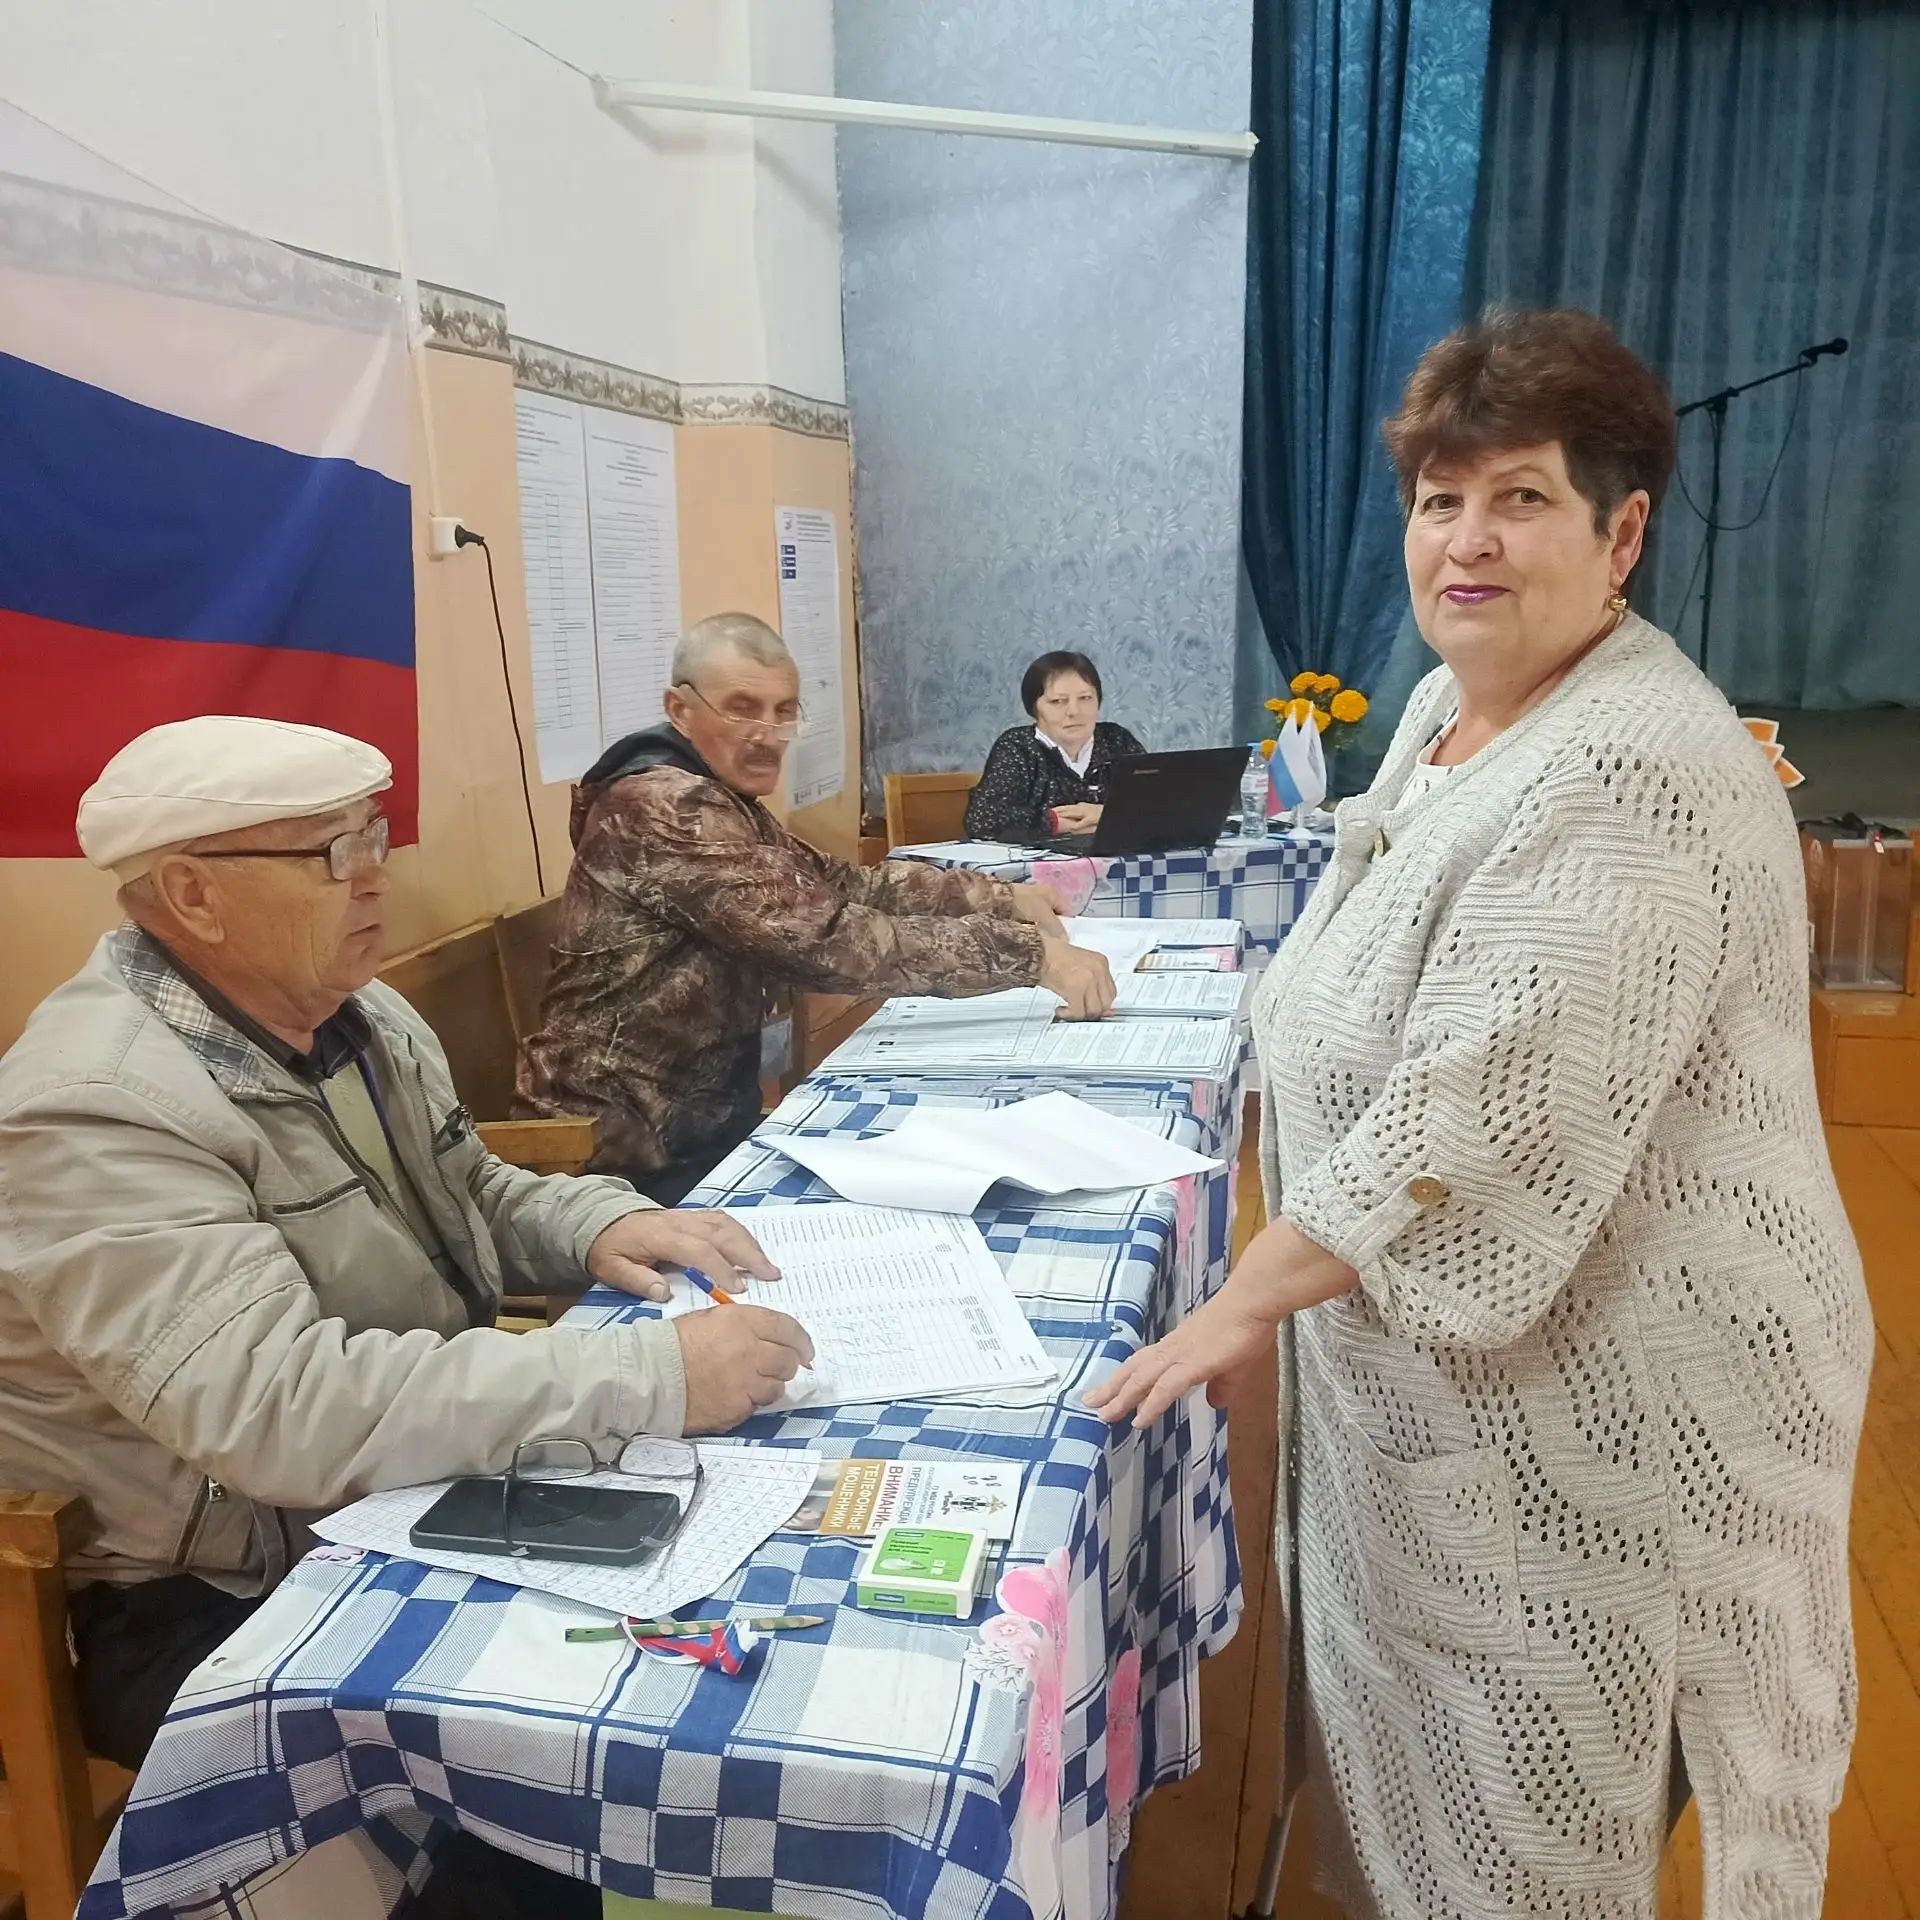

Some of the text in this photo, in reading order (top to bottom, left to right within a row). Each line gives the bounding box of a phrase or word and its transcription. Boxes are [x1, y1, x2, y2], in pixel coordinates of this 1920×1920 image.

[829, 1466, 861, 1528] МОШЕННИКИ
[846, 1464, 880, 1531] ТЕЛЕФОННЫЕ
[897, 1467, 922, 1524] ПРЕДУПРЕЖДА
